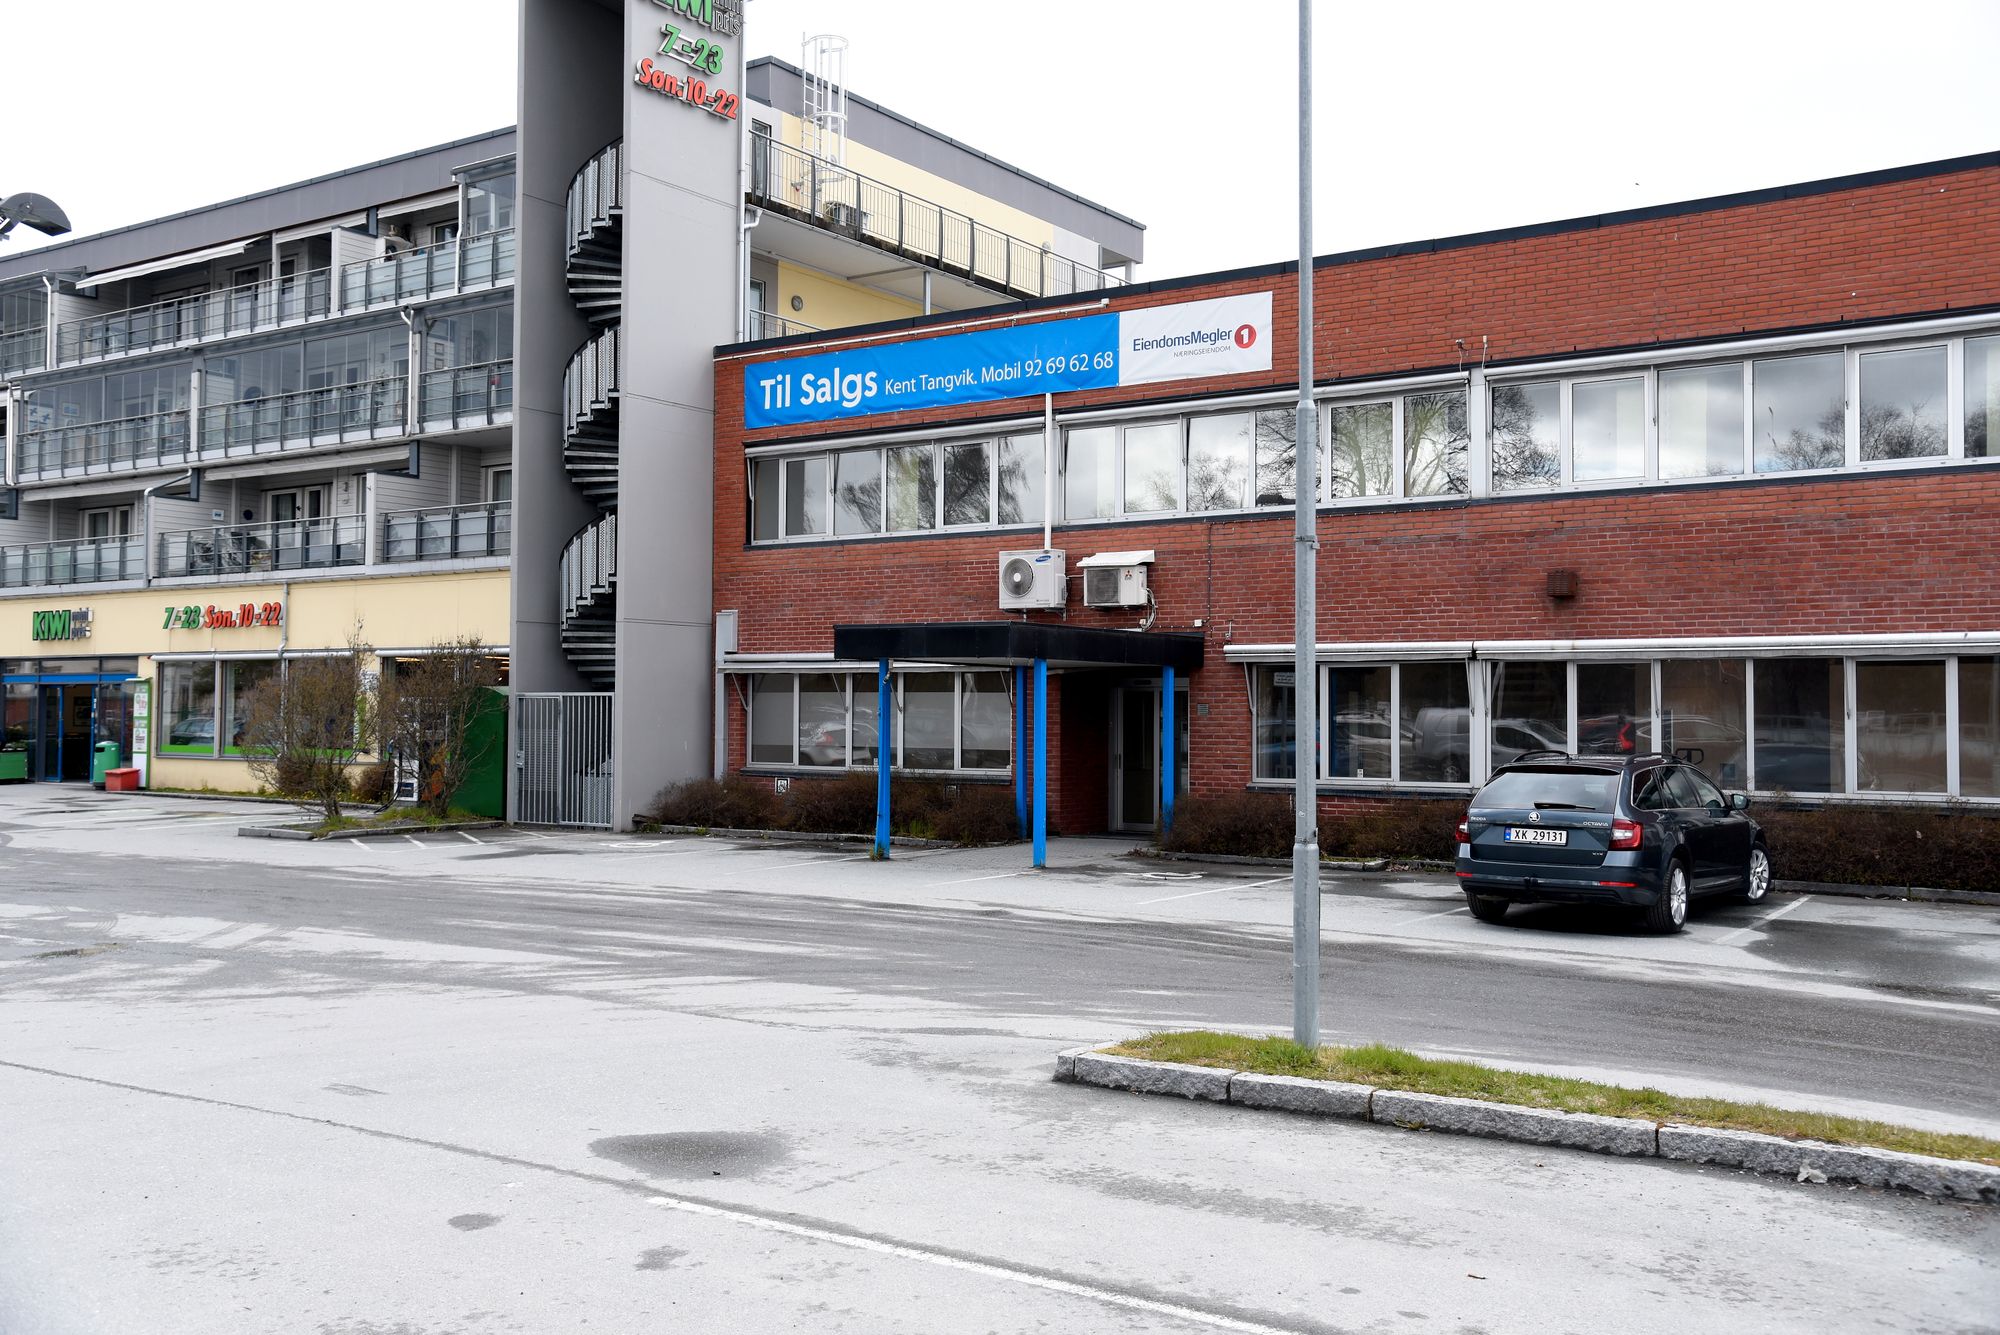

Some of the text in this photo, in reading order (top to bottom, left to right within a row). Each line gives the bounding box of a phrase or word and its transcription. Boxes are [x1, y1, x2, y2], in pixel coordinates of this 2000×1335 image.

[714, 10, 741, 36] pris
[638, 57, 740, 120] Søn. 10-22
[1133, 328, 1233, 351] EiendomsMegler
[1173, 345, 1232, 359] NÆRINGSEIENDOM
[760, 351, 1114, 410] Til Salgs Kent Tangvik. Mobil 92 69 62 68
[32, 609, 72, 641] KIWI
[204, 604, 238, 629] Søn.
[1514, 830, 1563, 842] XK 29131
